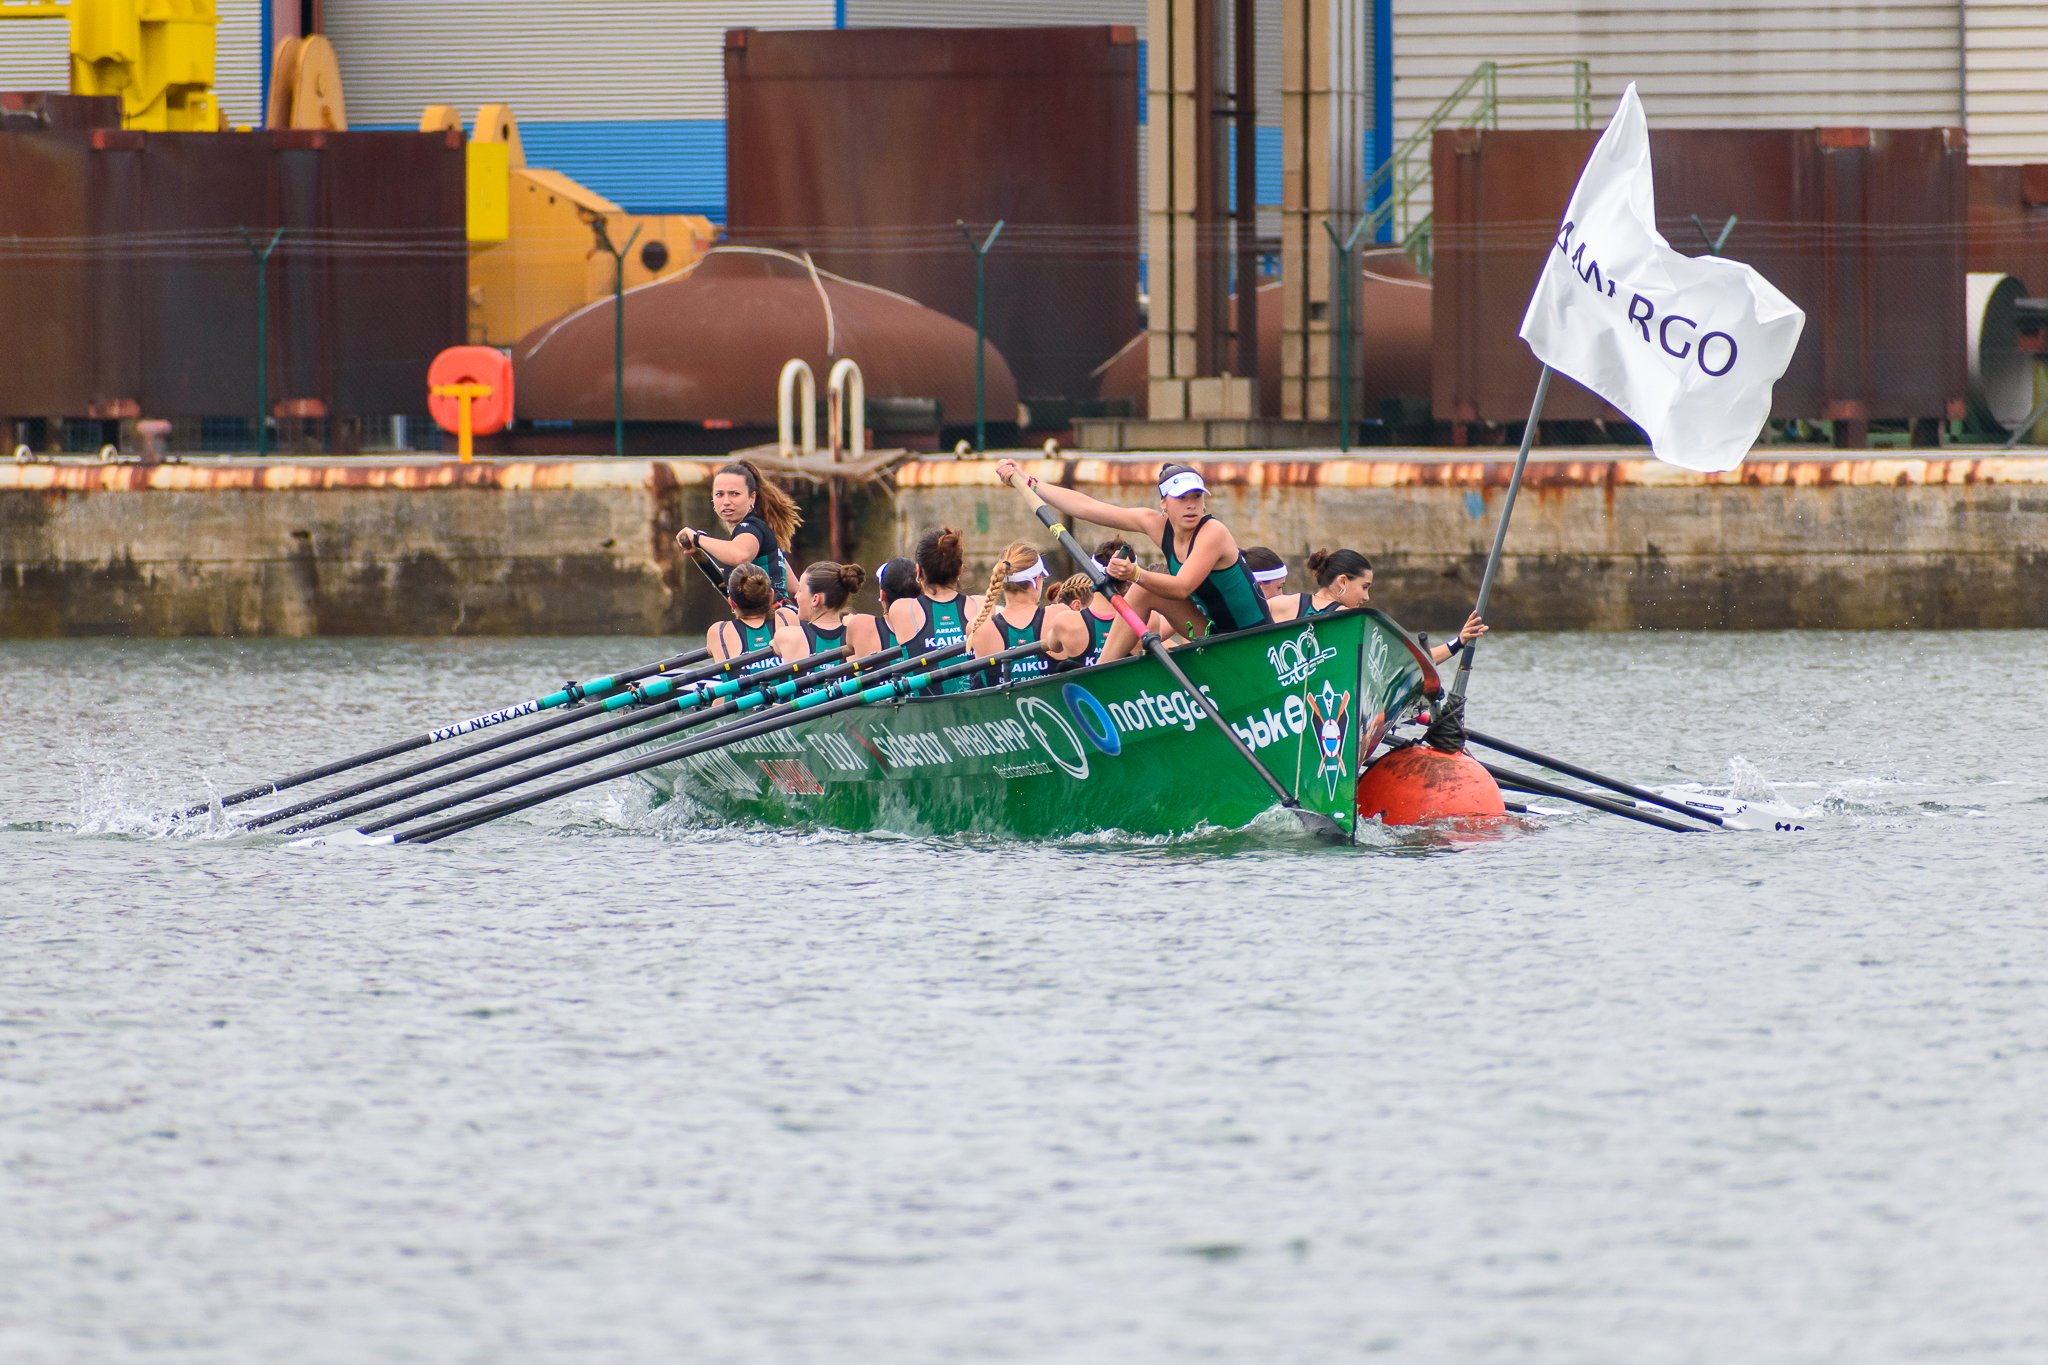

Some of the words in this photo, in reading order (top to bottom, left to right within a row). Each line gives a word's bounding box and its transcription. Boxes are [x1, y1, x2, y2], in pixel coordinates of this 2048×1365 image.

[1557, 221, 1738, 377] AMRGO
[924, 634, 968, 648] KAIK
[935, 626, 961, 635] ARRATE
[1267, 631, 1320, 675] 100
[433, 725, 467, 742] XXL
[470, 702, 534, 732] NESKAK
[943, 718, 1030, 757] AMBILAMP
[869, 722, 954, 769] sidenor
